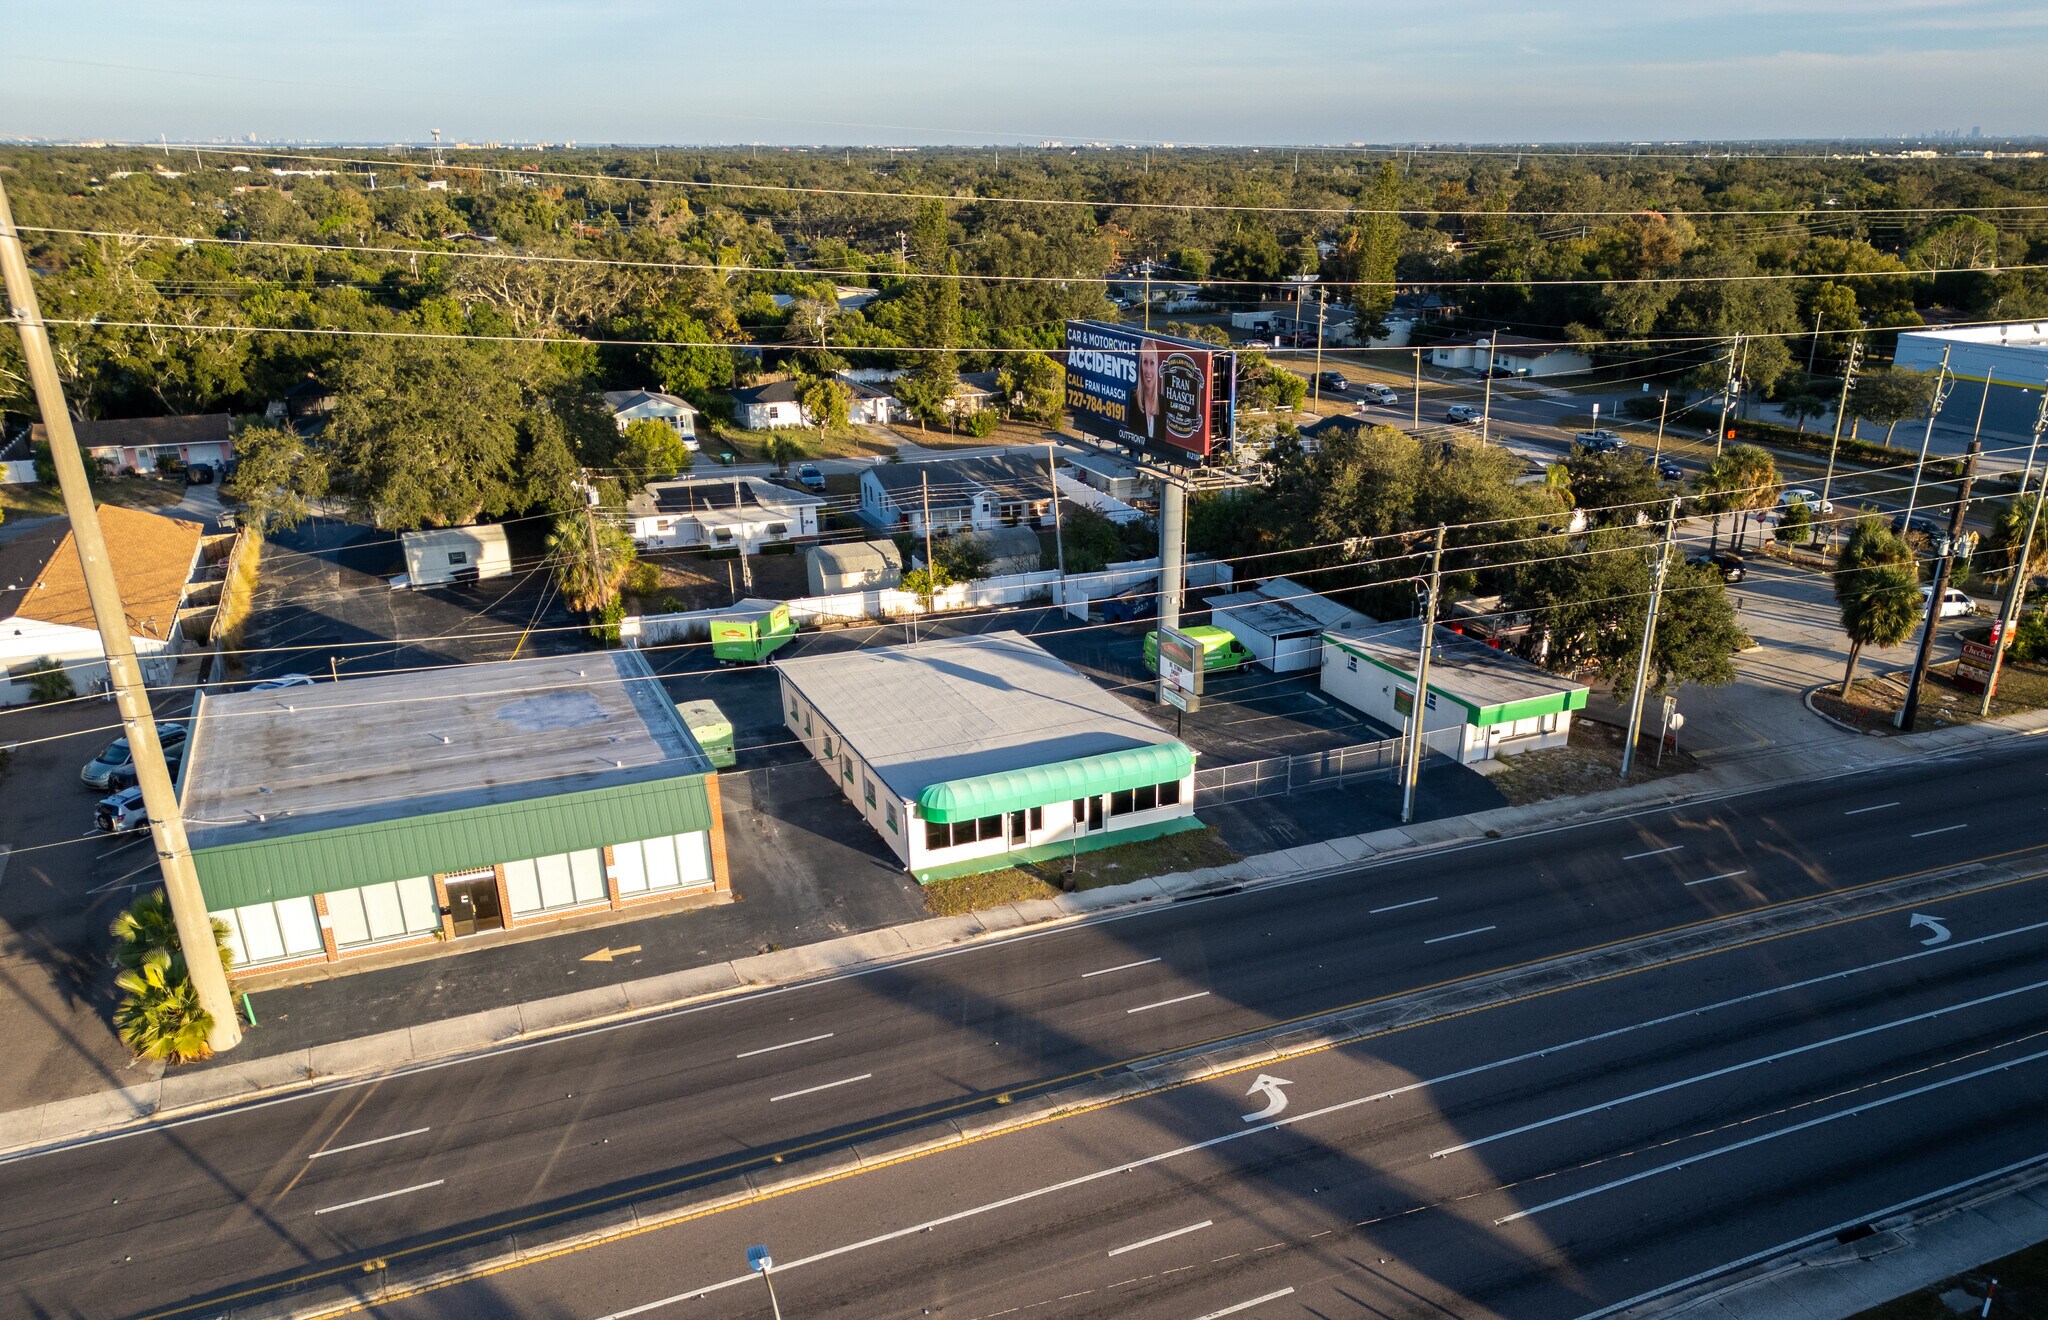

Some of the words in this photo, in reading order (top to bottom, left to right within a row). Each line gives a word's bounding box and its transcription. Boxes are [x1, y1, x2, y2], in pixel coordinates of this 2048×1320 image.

[1067, 328, 1082, 343] CAR
[1082, 332, 1088, 344] &
[1089, 333, 1136, 356] MOTORCYCLE
[1068, 345, 1137, 383] ACCIDENTS
[1067, 373, 1084, 389] CALL
[1085, 379, 1100, 394] FRAN
[1101, 383, 1126, 401] HAASCH
[1166, 386, 1195, 406] HAASCH
[1171, 374, 1190, 391] FRAN
[1067, 388, 1126, 422] 727-784-8191
